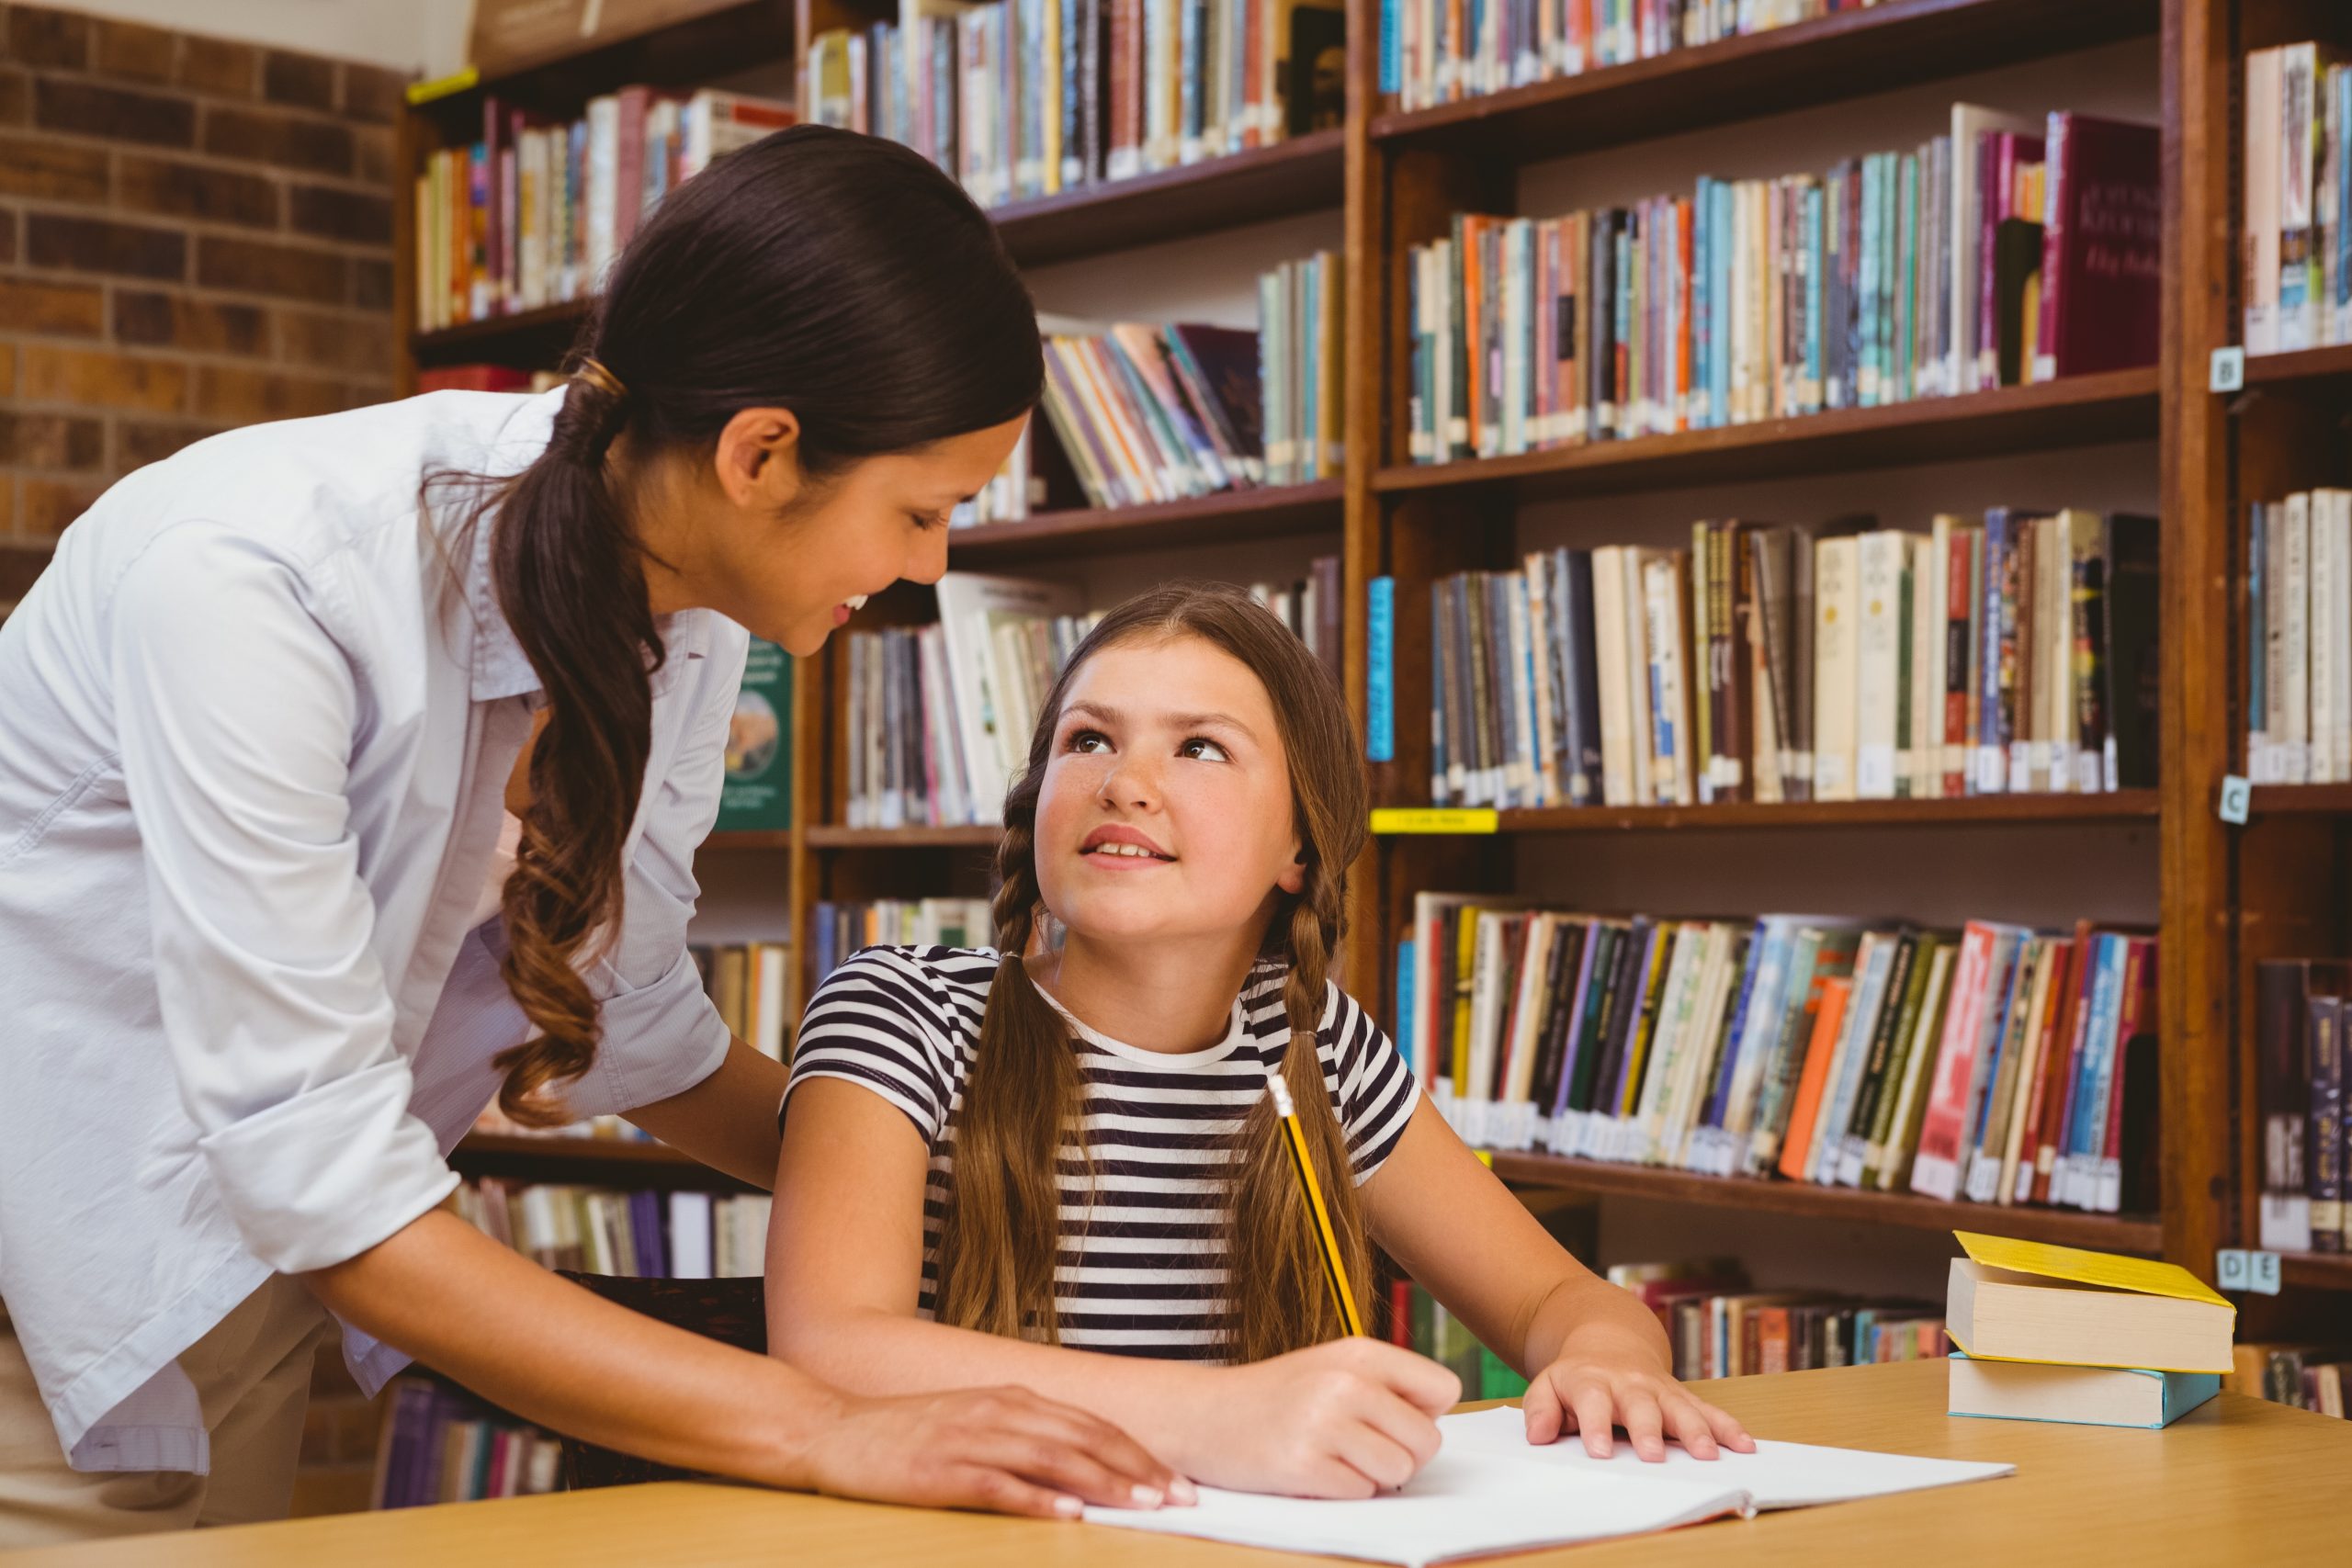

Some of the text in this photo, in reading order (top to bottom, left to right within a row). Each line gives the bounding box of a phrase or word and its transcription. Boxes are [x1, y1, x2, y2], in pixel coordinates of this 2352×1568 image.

[2227, 788, 2243, 813] C
[2224, 1254, 2276, 1280] D E
